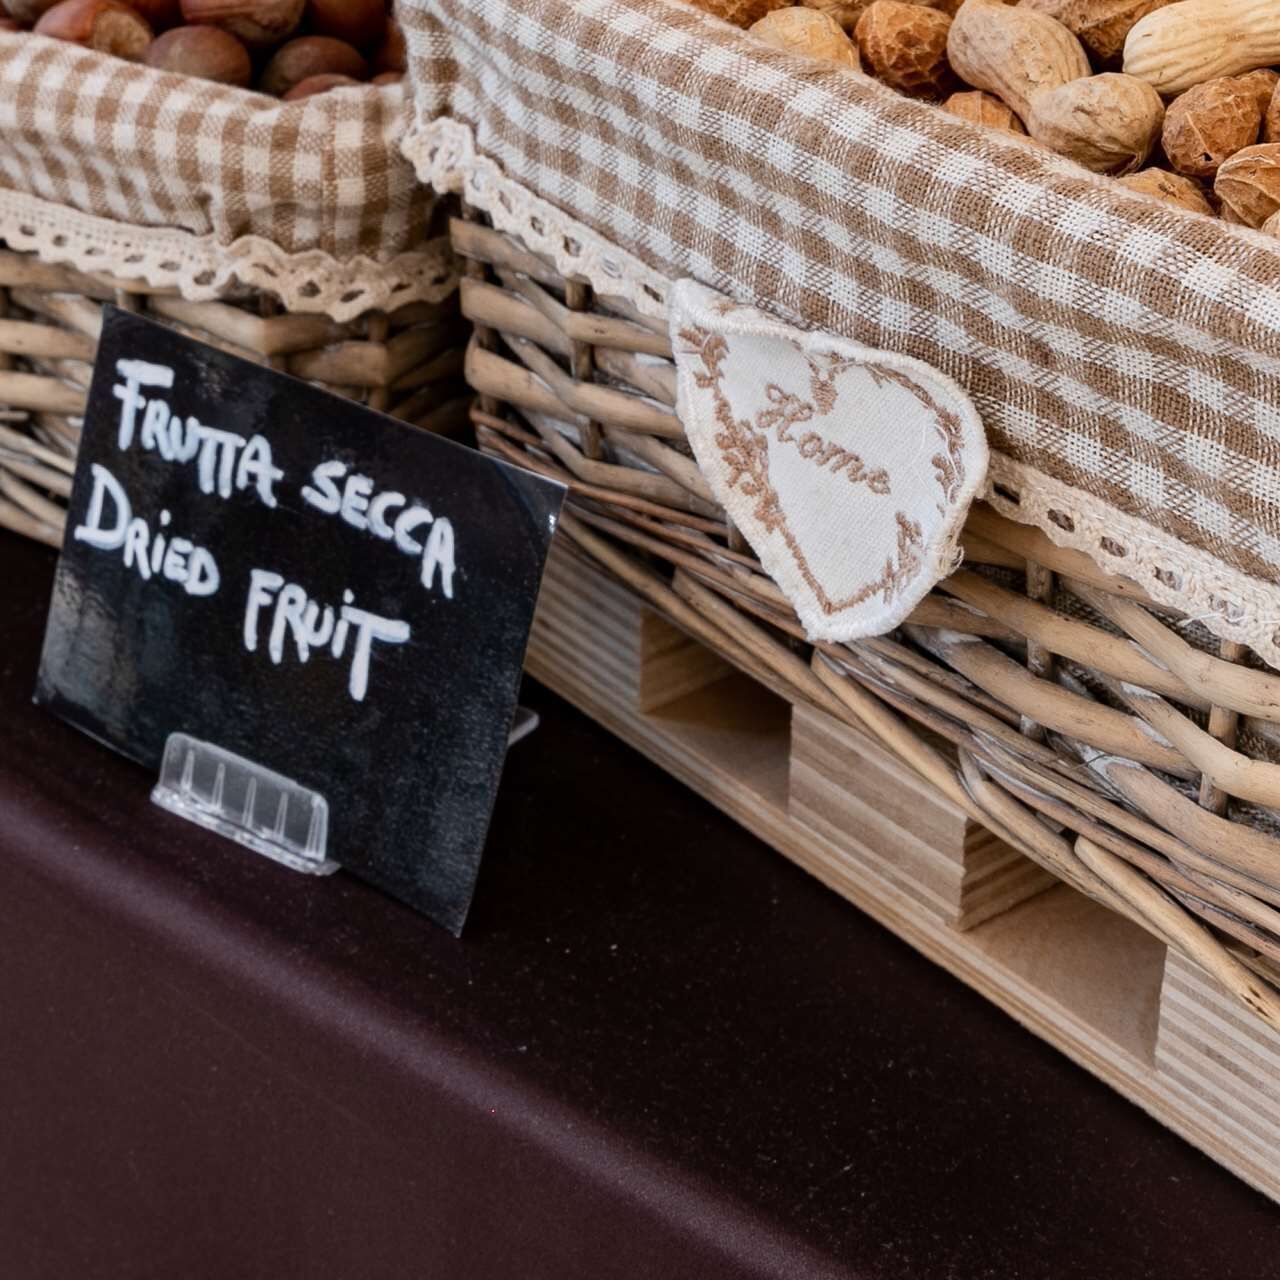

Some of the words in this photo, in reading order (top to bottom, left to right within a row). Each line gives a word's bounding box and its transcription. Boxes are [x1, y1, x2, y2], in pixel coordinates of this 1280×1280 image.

[113, 359, 284, 508] FRUTTA
[301, 460, 456, 599] SECCA
[756, 383, 891, 495] Home
